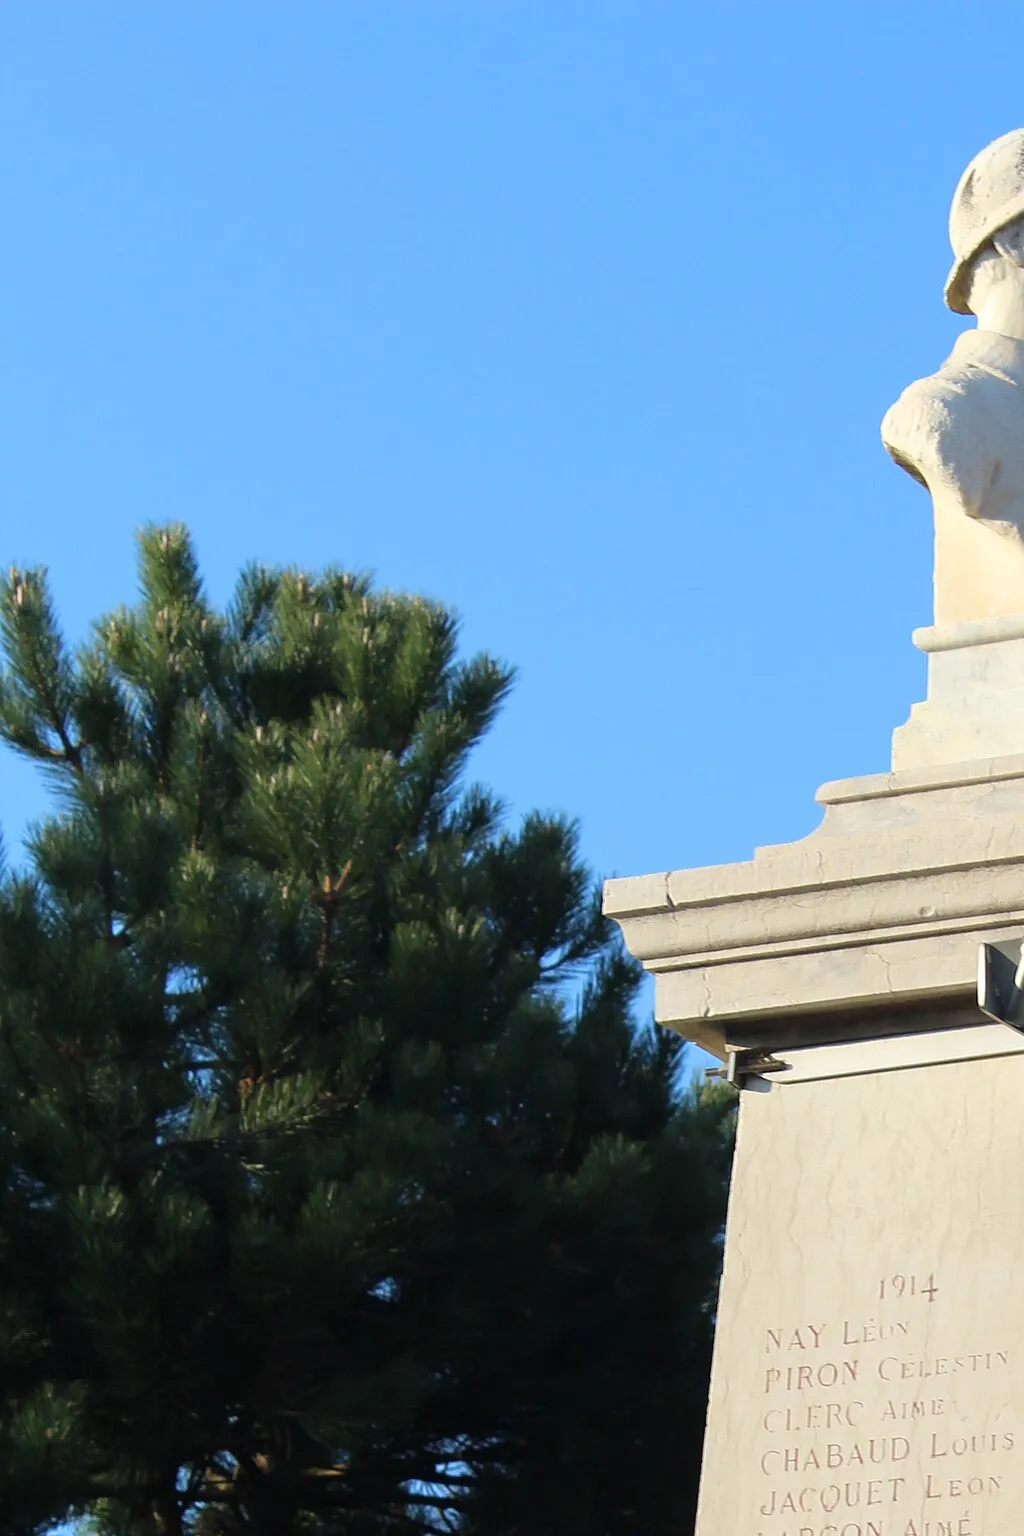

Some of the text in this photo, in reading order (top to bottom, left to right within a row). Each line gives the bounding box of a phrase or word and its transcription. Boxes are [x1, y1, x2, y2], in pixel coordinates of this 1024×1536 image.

[879, 1273, 939, 1302] 1914
[765, 1323, 826, 1353] NAY
[765, 1360, 859, 1393] PIRON
[763, 1401, 864, 1433] CLERC
[761, 1432, 1015, 1476] CHABAUD LOUIS
[760, 1477, 905, 1516] JACQUET
